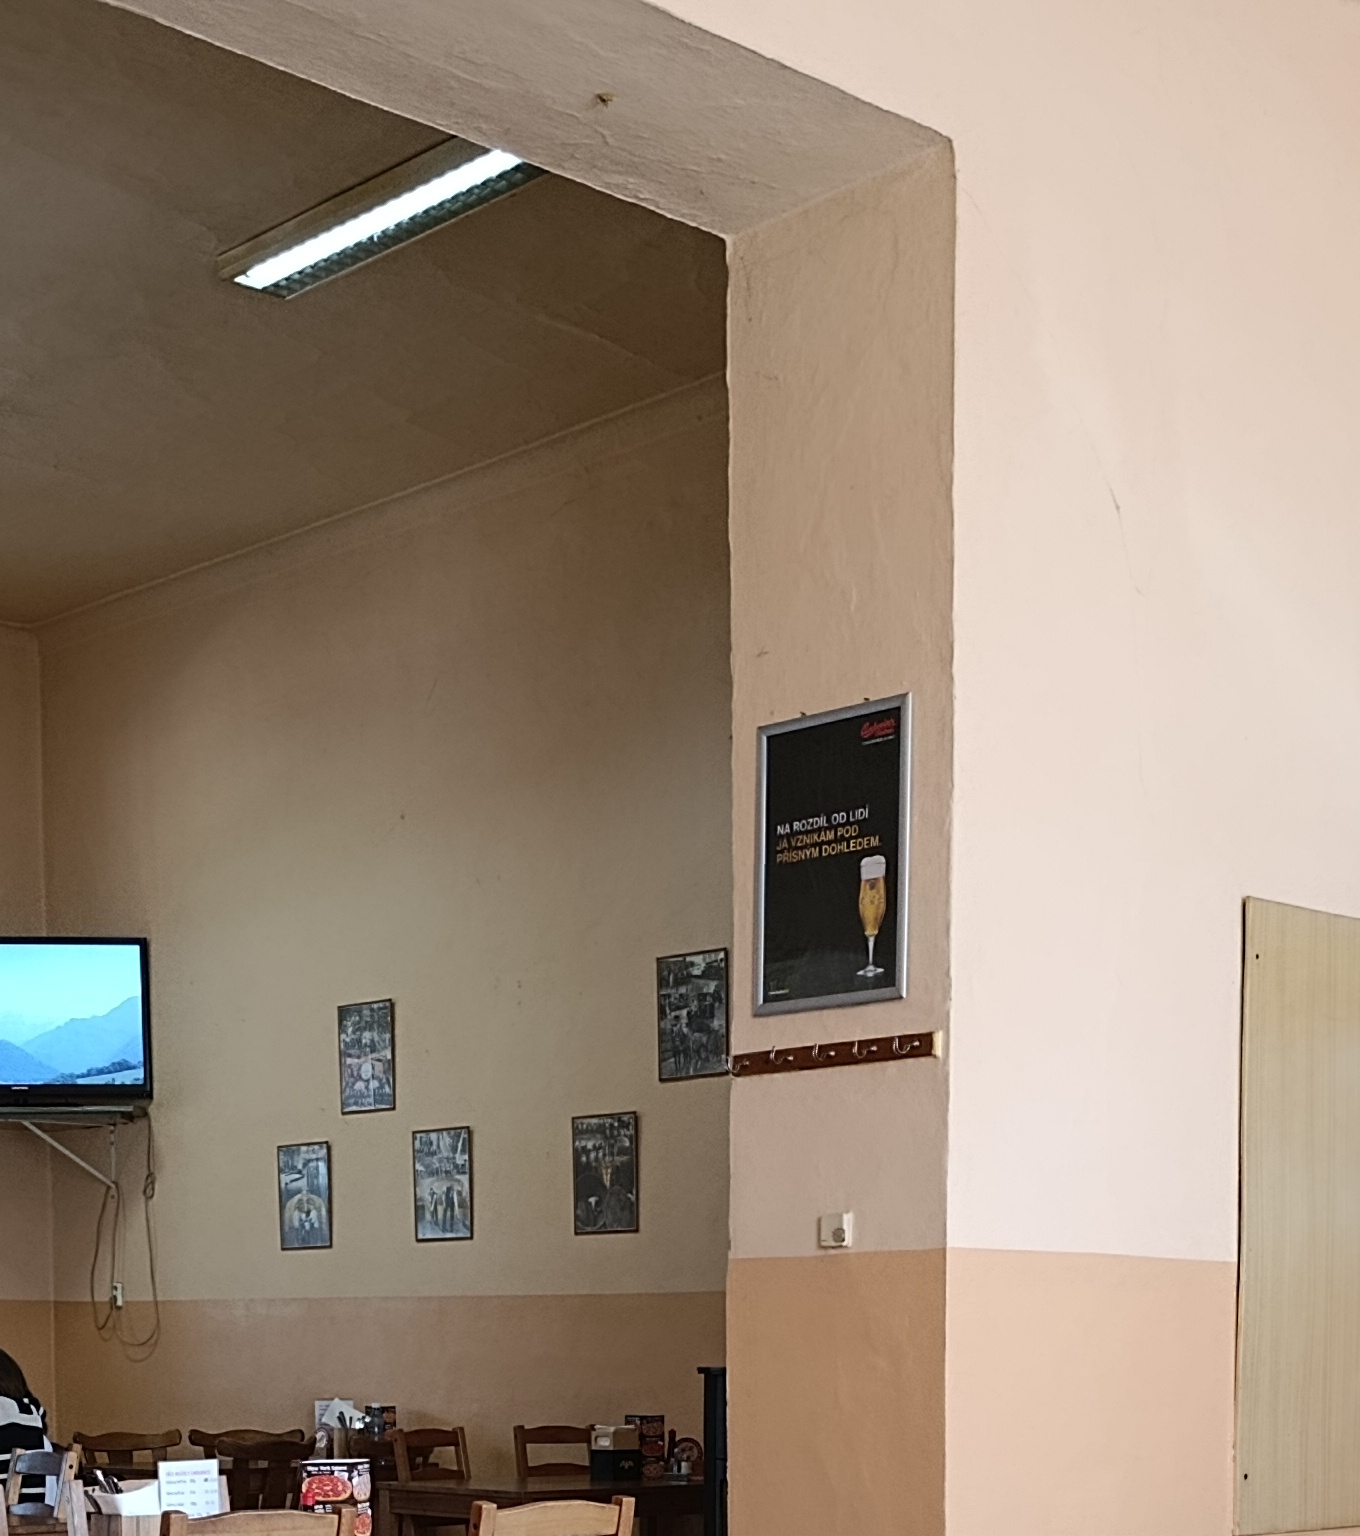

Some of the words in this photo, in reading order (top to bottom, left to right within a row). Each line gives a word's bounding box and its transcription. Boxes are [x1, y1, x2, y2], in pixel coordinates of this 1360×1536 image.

[777, 823, 790, 835] NA
[793, 813, 829, 832] ROZDÍL
[832, 812, 847, 824] OD
[850, 804, 869, 821] LIDÍ
[776, 838, 789, 850] JÁ
[790, 828, 835, 847] VZNIKÁM
[837, 825, 859, 838] POD
[776, 846, 819, 863] PŘÍSNÝM
